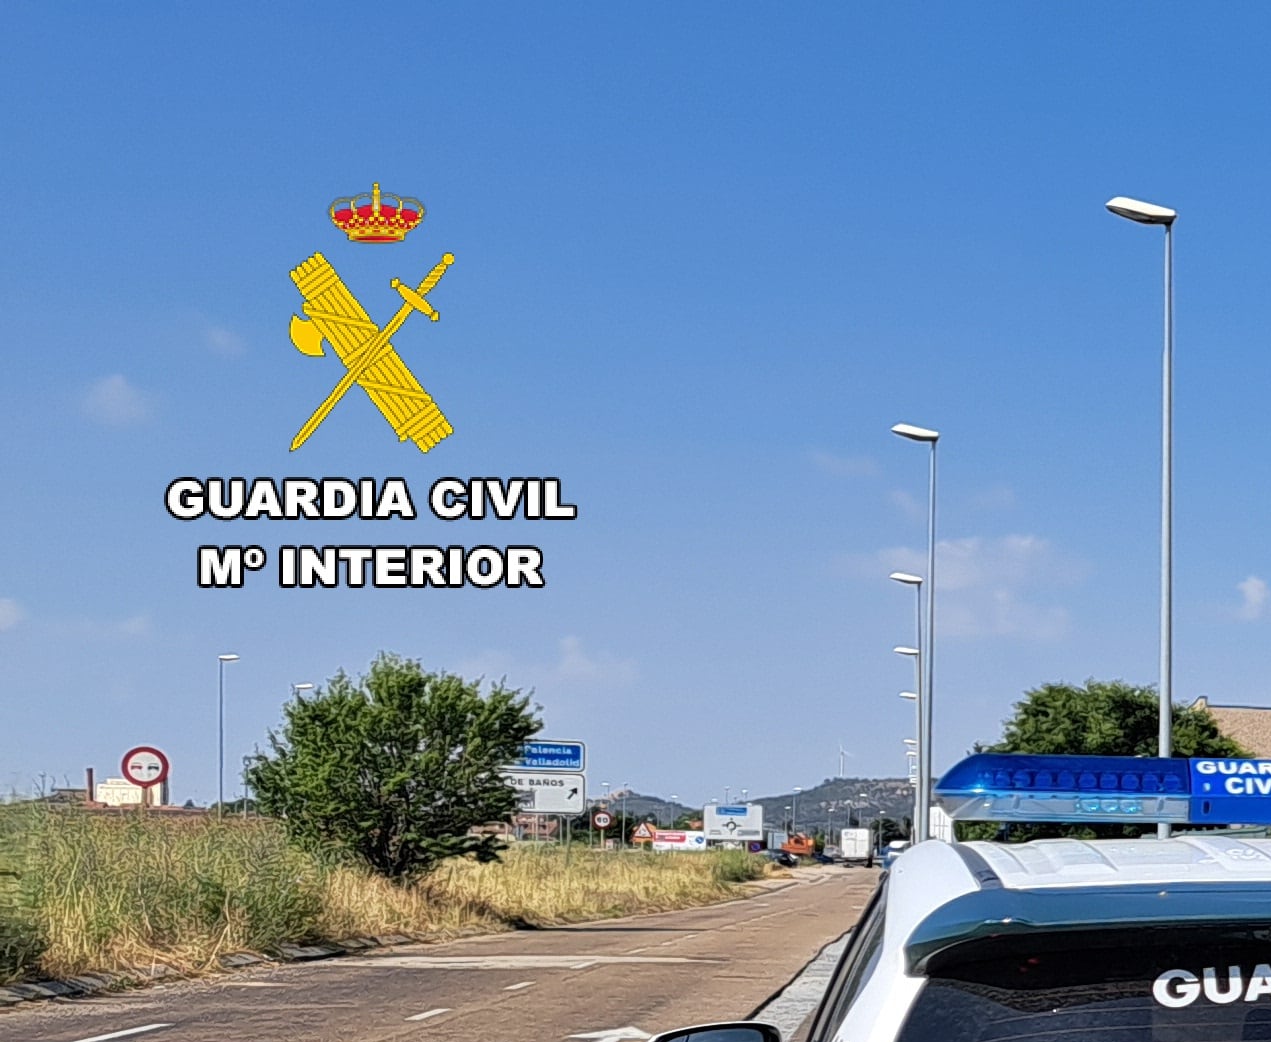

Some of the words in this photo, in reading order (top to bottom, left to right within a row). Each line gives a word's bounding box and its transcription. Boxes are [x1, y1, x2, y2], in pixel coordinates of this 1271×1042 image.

[524, 745, 572, 755] Palencia
[525, 757, 580, 767] Valladolid
[511, 778, 524, 786] DE
[529, 778, 565, 787] BAÑOS
